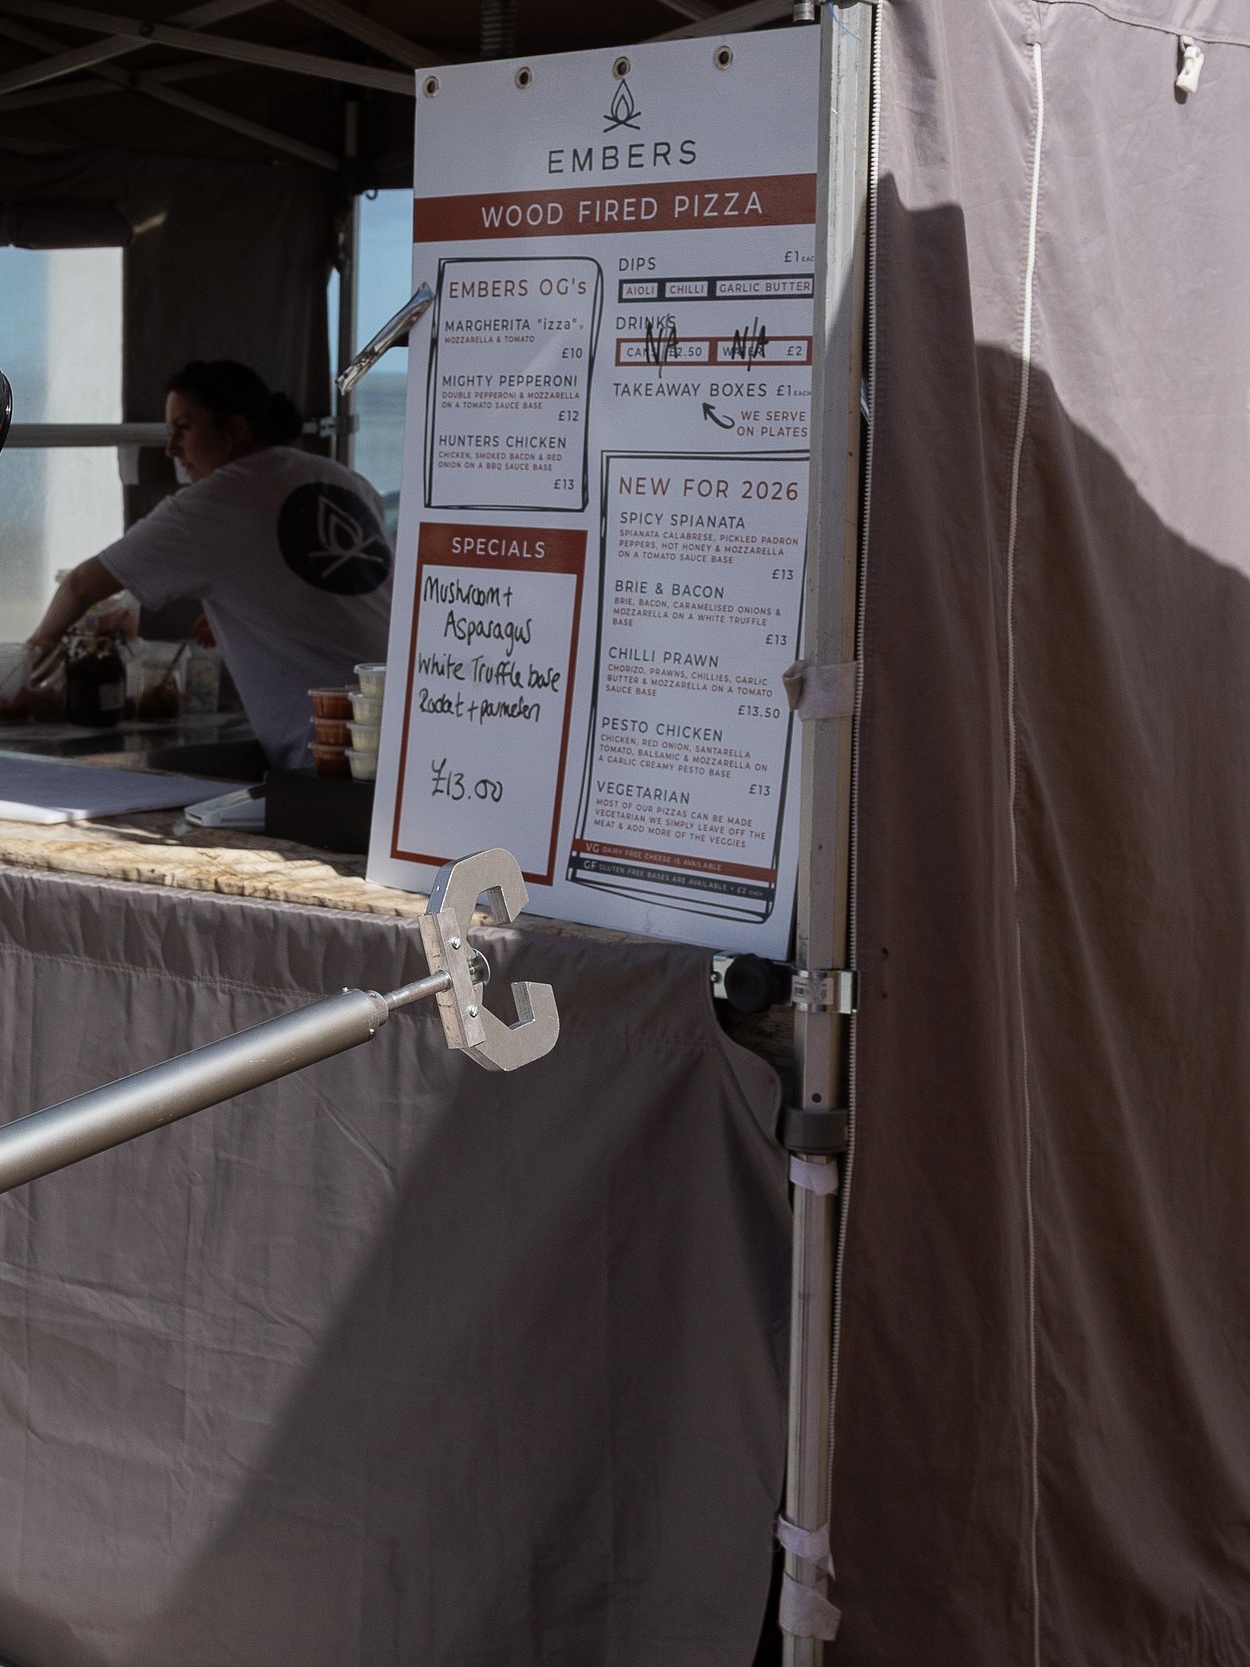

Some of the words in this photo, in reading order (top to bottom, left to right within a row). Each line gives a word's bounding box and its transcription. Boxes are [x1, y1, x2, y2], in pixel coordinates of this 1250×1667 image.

[548, 140, 698, 173] EMBERS
[481, 203, 563, 229] WOOD
[578, 197, 657, 222] FIRED
[675, 191, 763, 218] PIZZA
[619, 257, 656, 271] DIPS
[784, 251, 799, 263] £1
[450, 280, 528, 298] EMBERS
[540, 278, 586, 295] OG's
[626, 286, 655, 295] AIOLI
[670, 285, 704, 294] CHILLI
[719, 283, 760, 293] GARLIC
[766, 281, 810, 292] BUTTER
[445, 319, 530, 332] MARGHERITA
[616, 316, 676, 330] DRINKS
[562, 348, 582, 358] £10
[646, 313, 678, 379] N/A
[732, 317, 768, 372] N/A
[787, 346, 802, 356] £2
[442, 376, 492, 387] MIGHTY
[500, 375, 577, 387] PEPPERONI
[613, 383, 700, 397] TAKEAWAY
[710, 383, 767, 397] BOXES
[776, 385, 791, 396] £1
[558, 411, 579, 421] £12
[741, 411, 760, 421] WE
[766, 411, 806, 421] SERVE
[737, 427, 754, 436] ON
[761, 427, 808, 437] PLATES
[439, 435, 499, 447] HUNTERS
[506, 436, 566, 448] CHICKEN
[475, 452, 506, 460] SMOKED
[487, 462, 502, 470] BBQ
[533, 463, 552, 471] BASE
[554, 479, 574, 490] £13
[620, 477, 670, 495] NEW
[684, 479, 729, 498] FOR
[742, 481, 798, 501] 2026
[621, 512, 663, 525] SPICY
[671, 514, 745, 529] SPIANATA
[620, 530, 659, 538] SPIANATA
[720, 535, 757, 543] PICKLED
[761, 537, 799, 545] PADRON
[452, 537, 545, 558] SPECIALS
[662, 542, 678, 550] HOT
[683, 544, 711, 552] HONEY
[725, 546, 784, 556] MOZZARELLA
[643, 552, 676, 561] TOMATO
[680, 554, 707, 562] SAUCE
[711, 556, 733, 564] BASE
[772, 569, 794, 580] £13
[615, 580, 647, 594] BRIE
[655, 583, 664, 595] &
[672, 584, 724, 599] BACON
[674, 601, 734, 612] CARAMELISED
[738, 606, 772, 615] ONIONS
[613, 618, 633, 626] BASE
[614, 608, 669, 619] MOZZARELLA
[698, 614, 725, 623] WHITE
[729, 616, 767, 626] TRUFFLE
[444, 610, 532, 657] Asparagus
[766, 634, 787, 645] £13
[609, 646, 655, 662] CHILLI
[663, 652, 719, 668] PRAWN
[472, 655, 524, 689] Truffle
[607, 675, 639, 684] BUTTER
[651, 679, 707, 691] MOZZARELLA
[711, 684, 724, 692] ON
[738, 686, 773, 697] TOMATO
[736, 676, 768, 686] GARLIC
[606, 685, 632, 694] SAUCE
[636, 688, 657, 696] BASE
[738, 705, 780, 719] £13.50
[602, 717, 648, 733] PESTO
[656, 723, 723, 742] CHICKEN
[643, 739, 658, 747] RED
[695, 745, 750, 758] SANTARELLA
[638, 749, 680, 761] BALSAMIC
[693, 755, 750, 769] MOZZARELLA
[607, 756, 637, 766] GARLIC
[640, 760, 674, 770] CREAMY
[678, 765, 705, 775] PESTO
[709, 769, 731, 778] BASE
[431, 759, 503, 802] £13.00
[597, 780, 689, 804] VEGETARIAN
[749, 784, 770, 796] £13
[596, 799, 618, 808] MOST
[636, 803, 653, 812] OUR
[657, 806, 687, 817] PIZZAS
[691, 812, 708, 821] CAN
[713, 815, 723, 823] BE
[728, 817, 752, 827] MADE
[595, 809, 645, 822] VEGETARIAN
[650, 817, 662, 825] WE
[666, 819, 694, 829] SIMPLY
[699, 824, 724, 834] LEAVE
[728, 828, 745, 837] OFF
[750, 831, 766, 840] THE
[594, 819, 615, 828] MEAT
[627, 824, 644, 832] ADD
[648, 827, 671, 837] MORE
[690, 833, 705, 842] THE
[710, 836, 746, 848] VEGGIES
[586, 842, 600, 853] VG
[603, 846, 622, 855] DAIRY
[625, 850, 642, 858] FREE
[645, 853, 670, 863] CHEESE
[683, 858, 722, 871] AVAILABLE
[584, 860, 596, 870] GF
